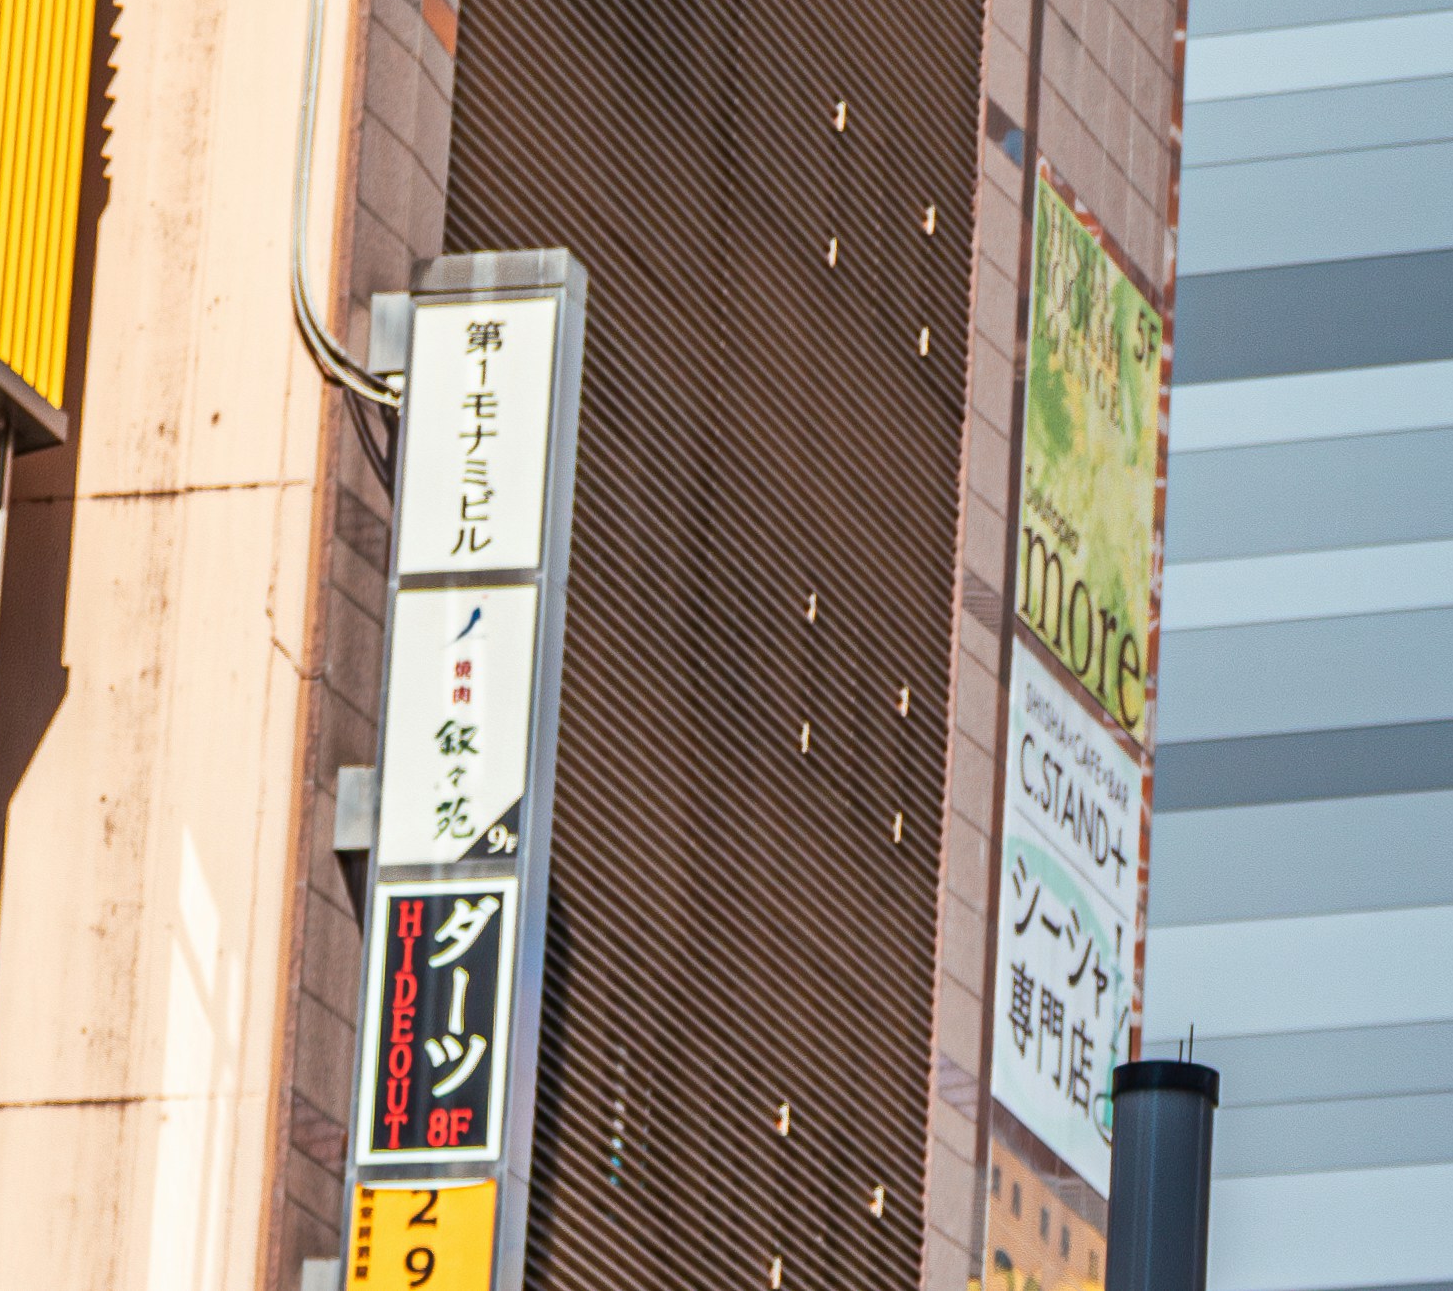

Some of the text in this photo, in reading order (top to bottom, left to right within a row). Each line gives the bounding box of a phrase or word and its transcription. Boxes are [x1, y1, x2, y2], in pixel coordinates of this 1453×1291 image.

[1133, 306, 1158, 372] 5F
[451, 320, 507, 557] 第1モナミビル
[1021, 526, 1140, 730] more
[1012, 853, 1109, 1019] シーシャ
[384, 899, 425, 1150] HIDEOUT
[1008, 960, 1095, 1118] 専門店
[427, 1108, 474, 1149] 8F
